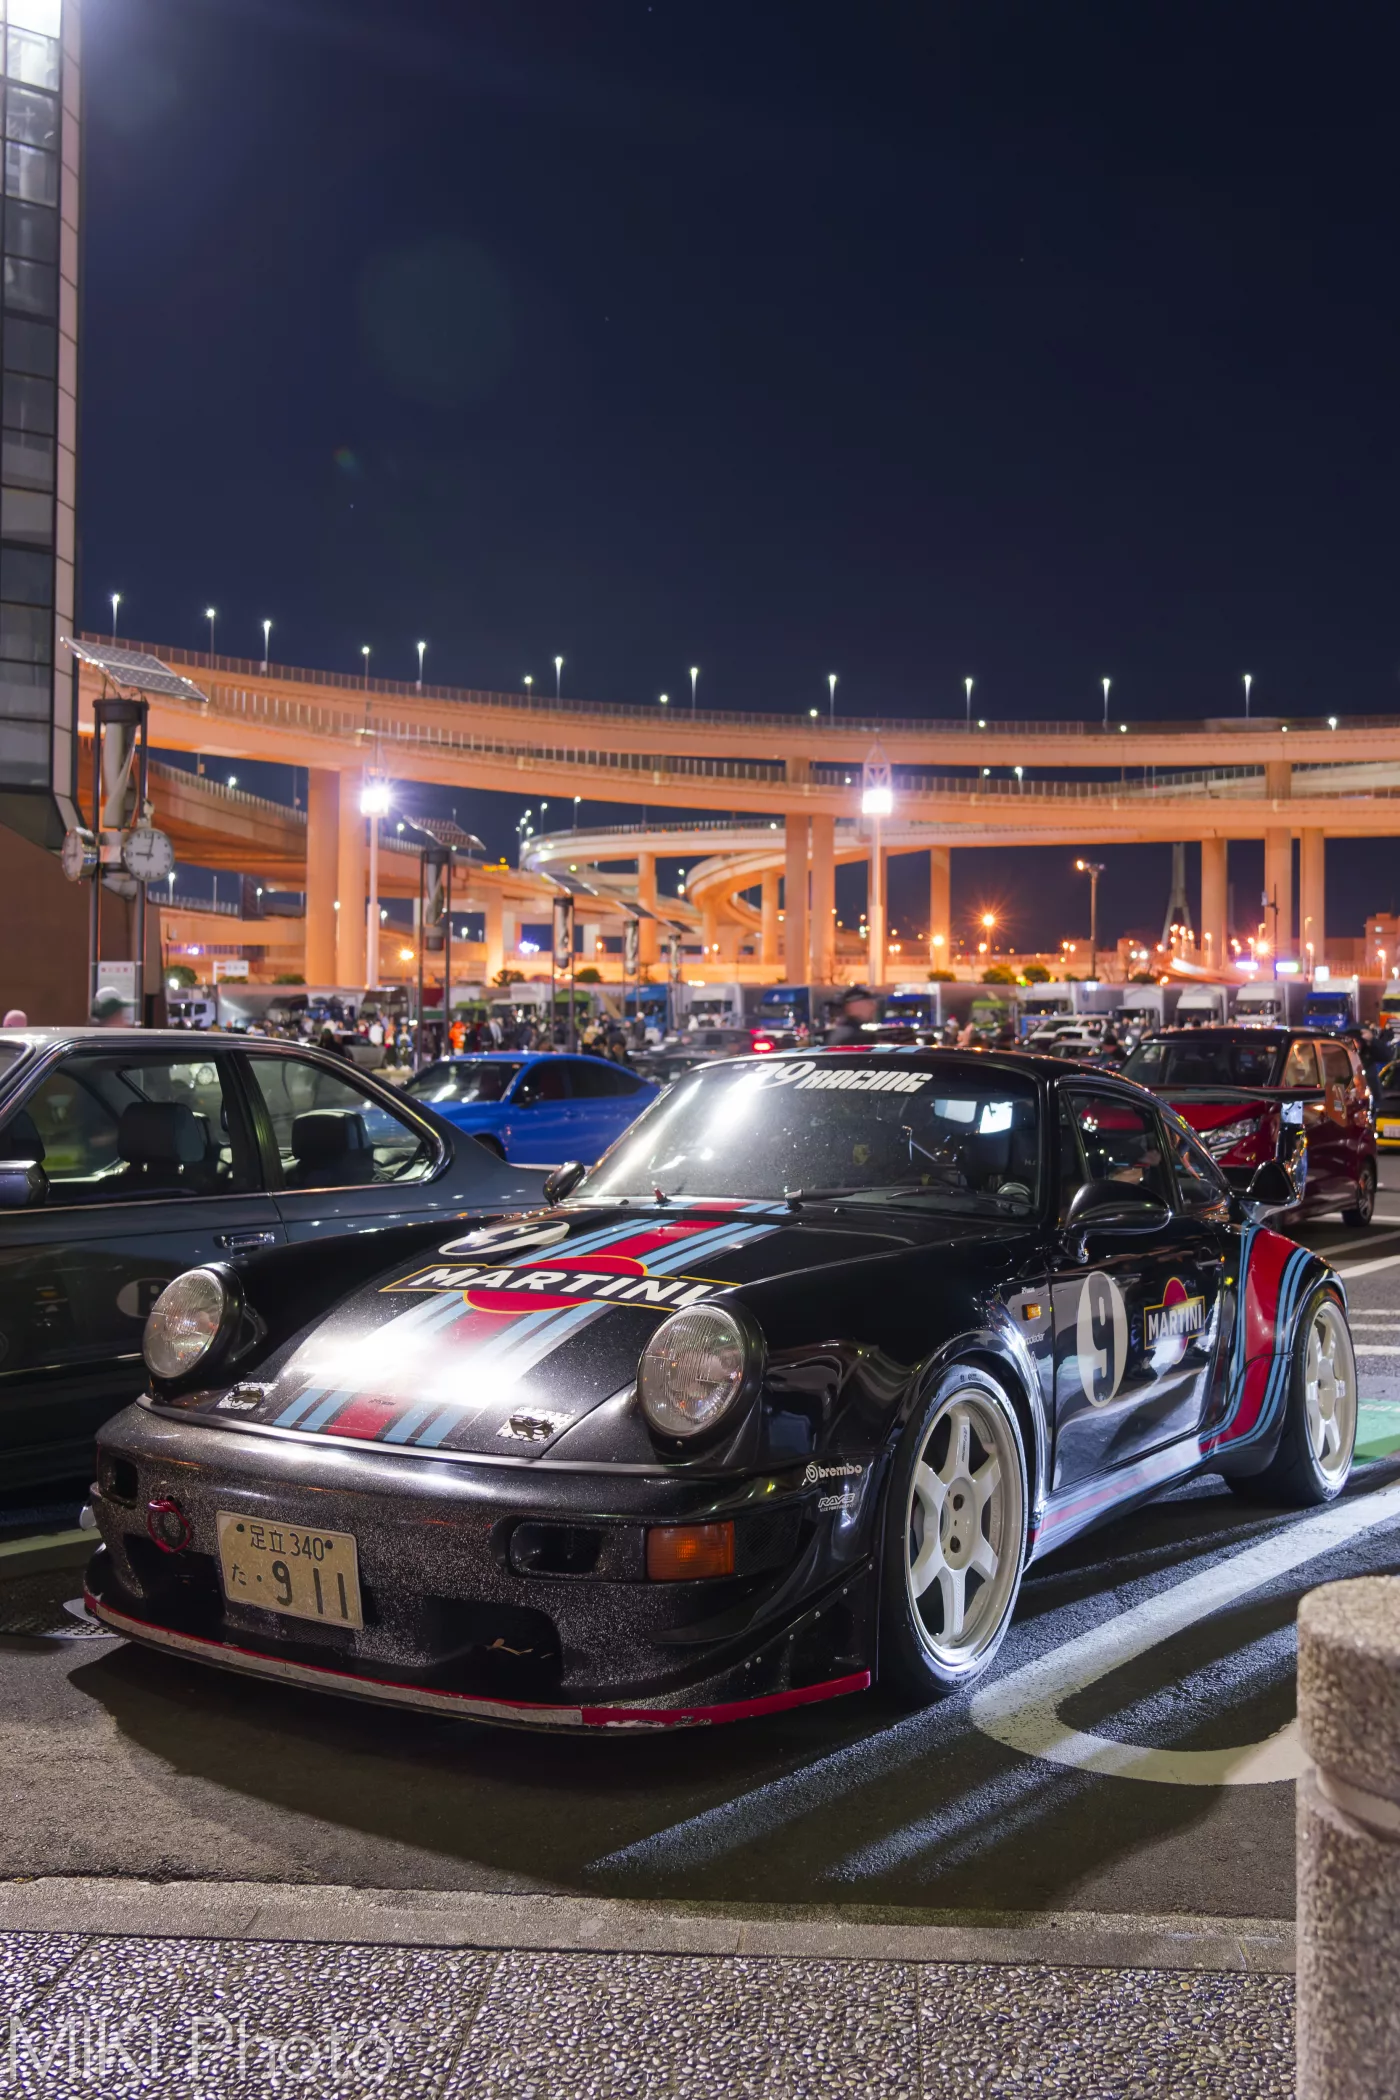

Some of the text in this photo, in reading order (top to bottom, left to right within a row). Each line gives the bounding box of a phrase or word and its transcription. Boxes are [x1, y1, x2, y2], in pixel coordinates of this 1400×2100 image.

[407, 1267, 714, 1306] MARTINI
[1088, 1274, 1115, 1403] 9
[1148, 1303, 1202, 1341] MARTINI
[818, 1463, 863, 1478] brembo
